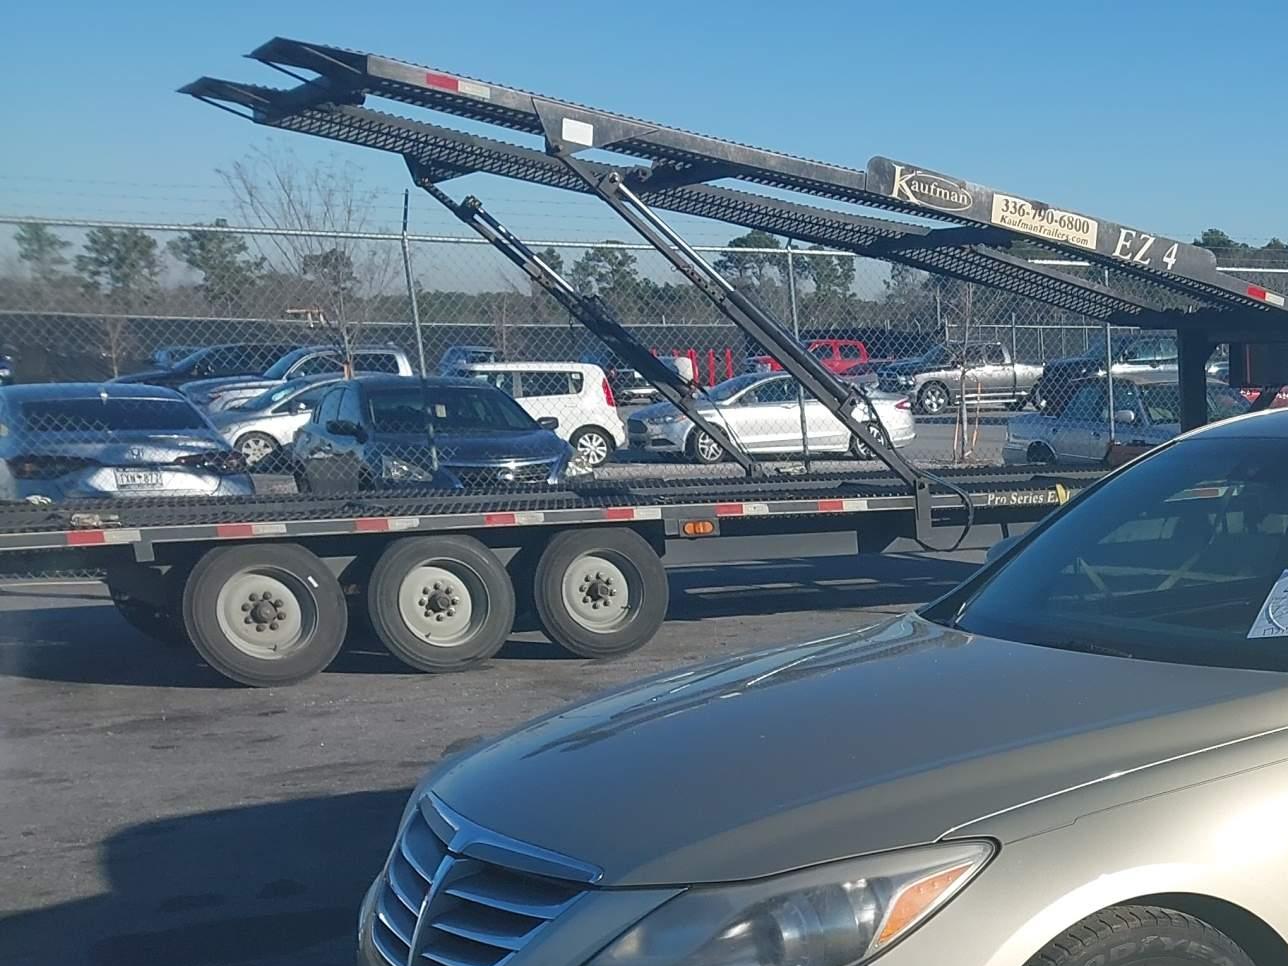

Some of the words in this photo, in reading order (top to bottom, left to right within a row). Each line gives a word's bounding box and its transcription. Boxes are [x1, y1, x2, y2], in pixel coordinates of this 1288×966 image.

[888, 163, 968, 206] Kaufman
[999, 214, 1089, 246] KaufmanTrailers.com
[1001, 198, 1090, 234] 336-790-6800
[1112, 227, 1156, 265] EZ
[1163, 242, 1179, 271] 4
[987, 493, 1007, 505] Pro
[1010, 492, 1044, 504] Series
